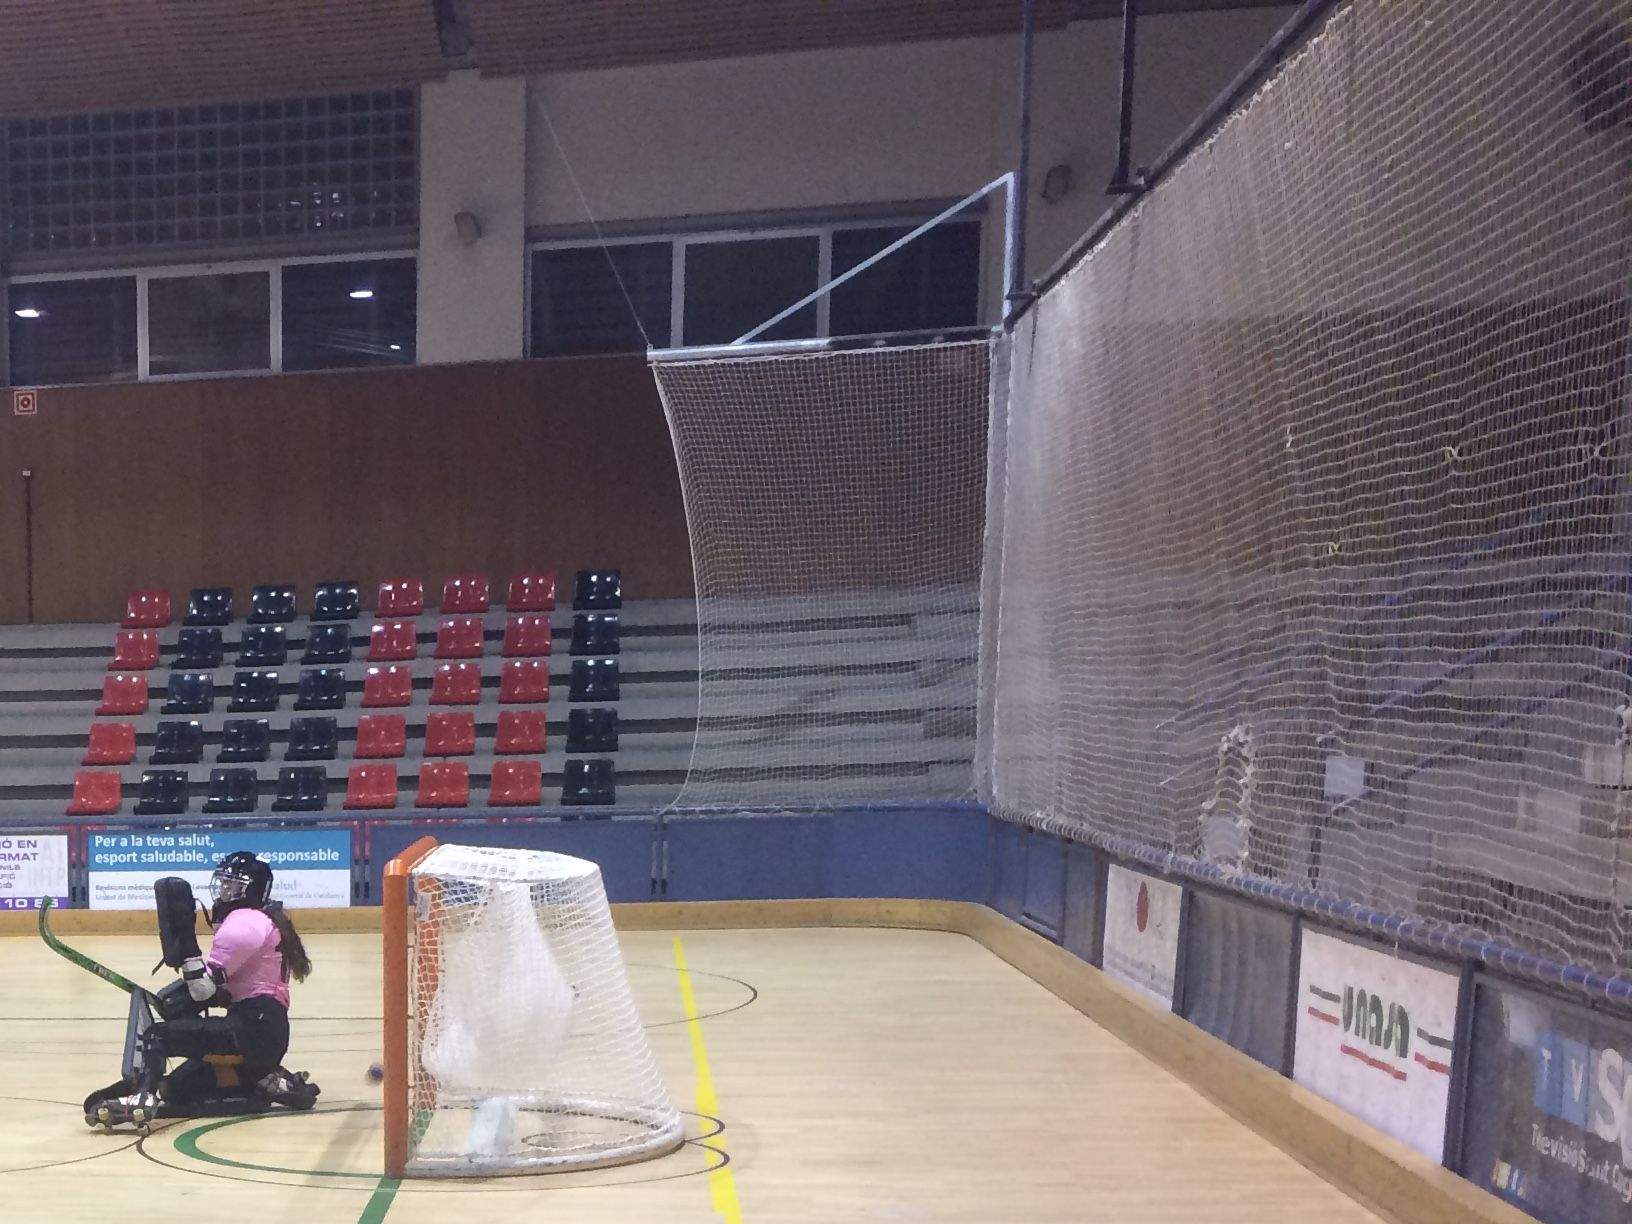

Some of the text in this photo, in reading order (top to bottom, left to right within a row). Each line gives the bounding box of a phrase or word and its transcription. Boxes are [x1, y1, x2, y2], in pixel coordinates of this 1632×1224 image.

[18, 840, 38, 849] EN
[94, 835, 118, 848] Per
[131, 834, 143, 847] la
[146, 835, 175, 847] teva
[178, 833, 215, 848] salut,
[94, 851, 138, 866] esport
[141, 849, 208, 864] saludable,
[4, 898, 29, 909] 10
